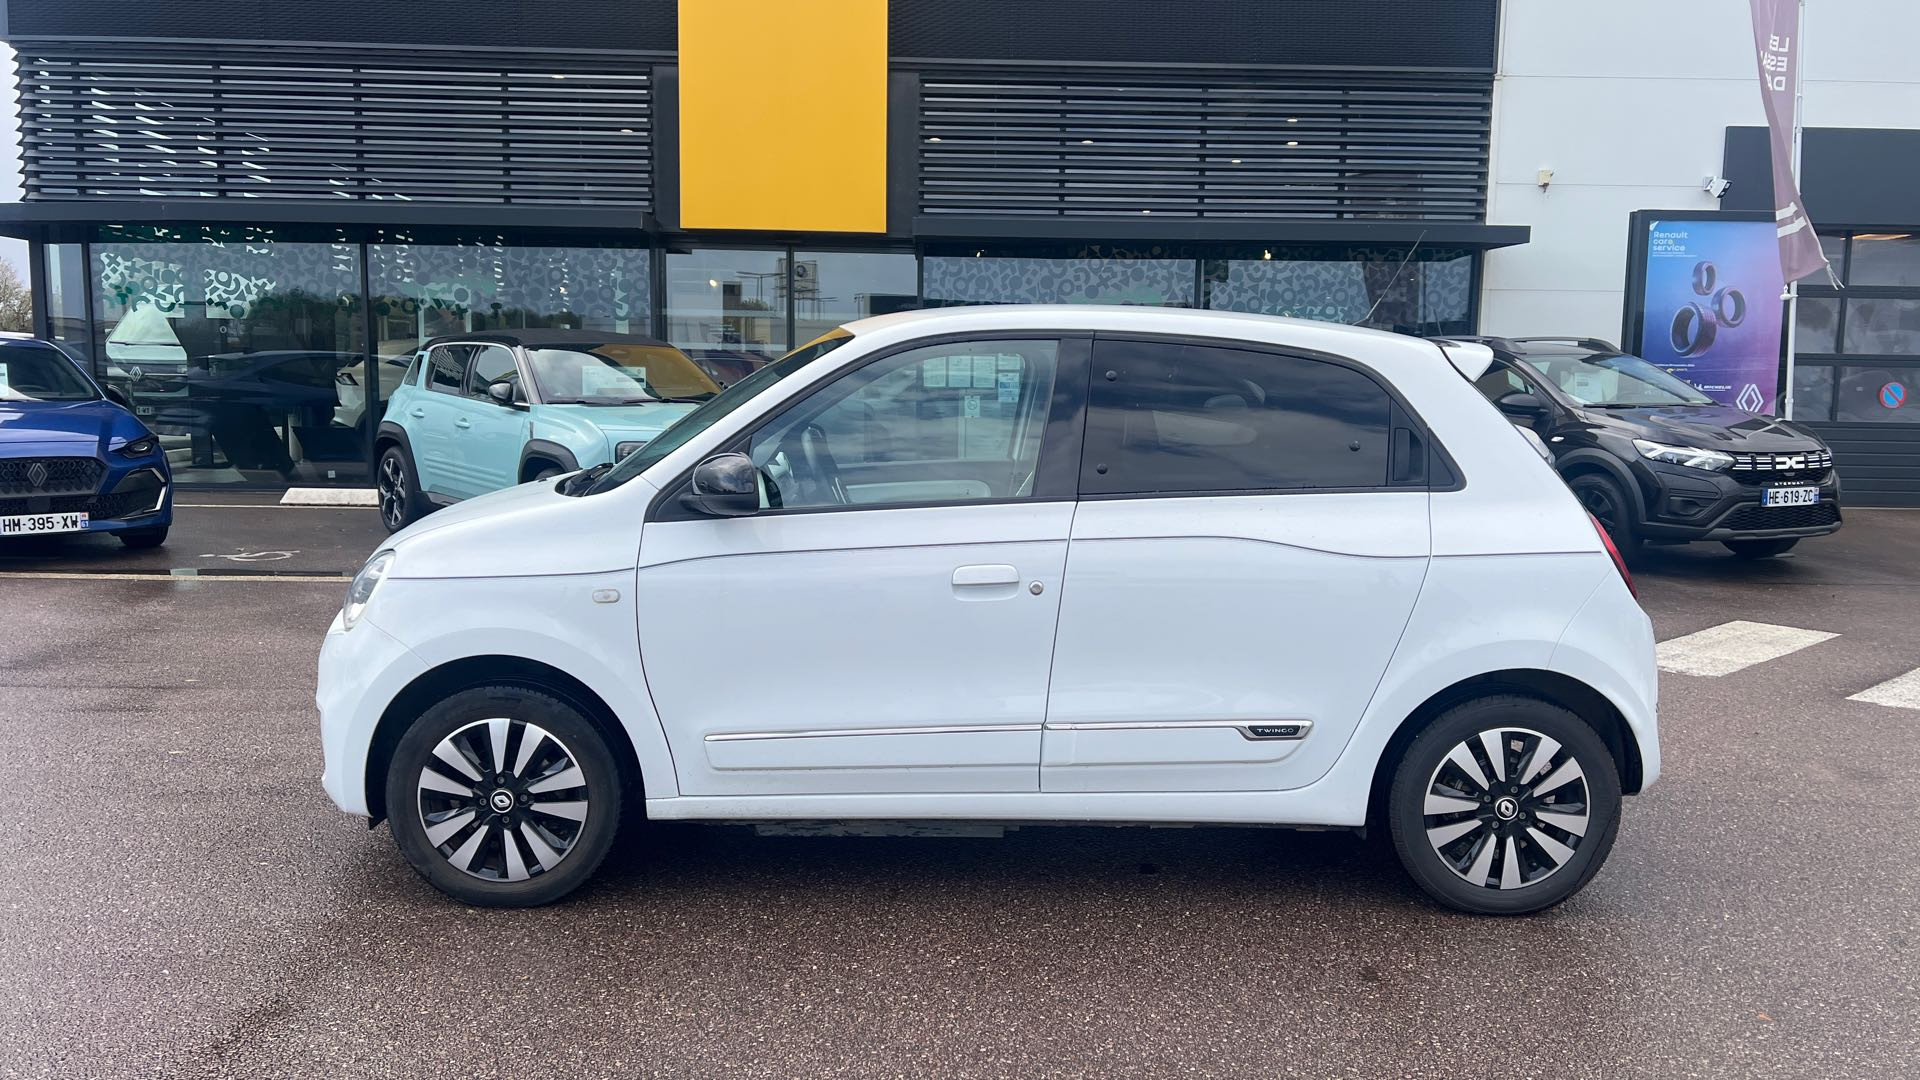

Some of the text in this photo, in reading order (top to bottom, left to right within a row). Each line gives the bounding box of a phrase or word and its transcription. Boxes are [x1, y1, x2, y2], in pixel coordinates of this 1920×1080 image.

[1653, 231, 1688, 239] Renault
[1768, 489, 1814, 505] HE-619-ZC
[2, 514, 79, 533] HM-395-XW
